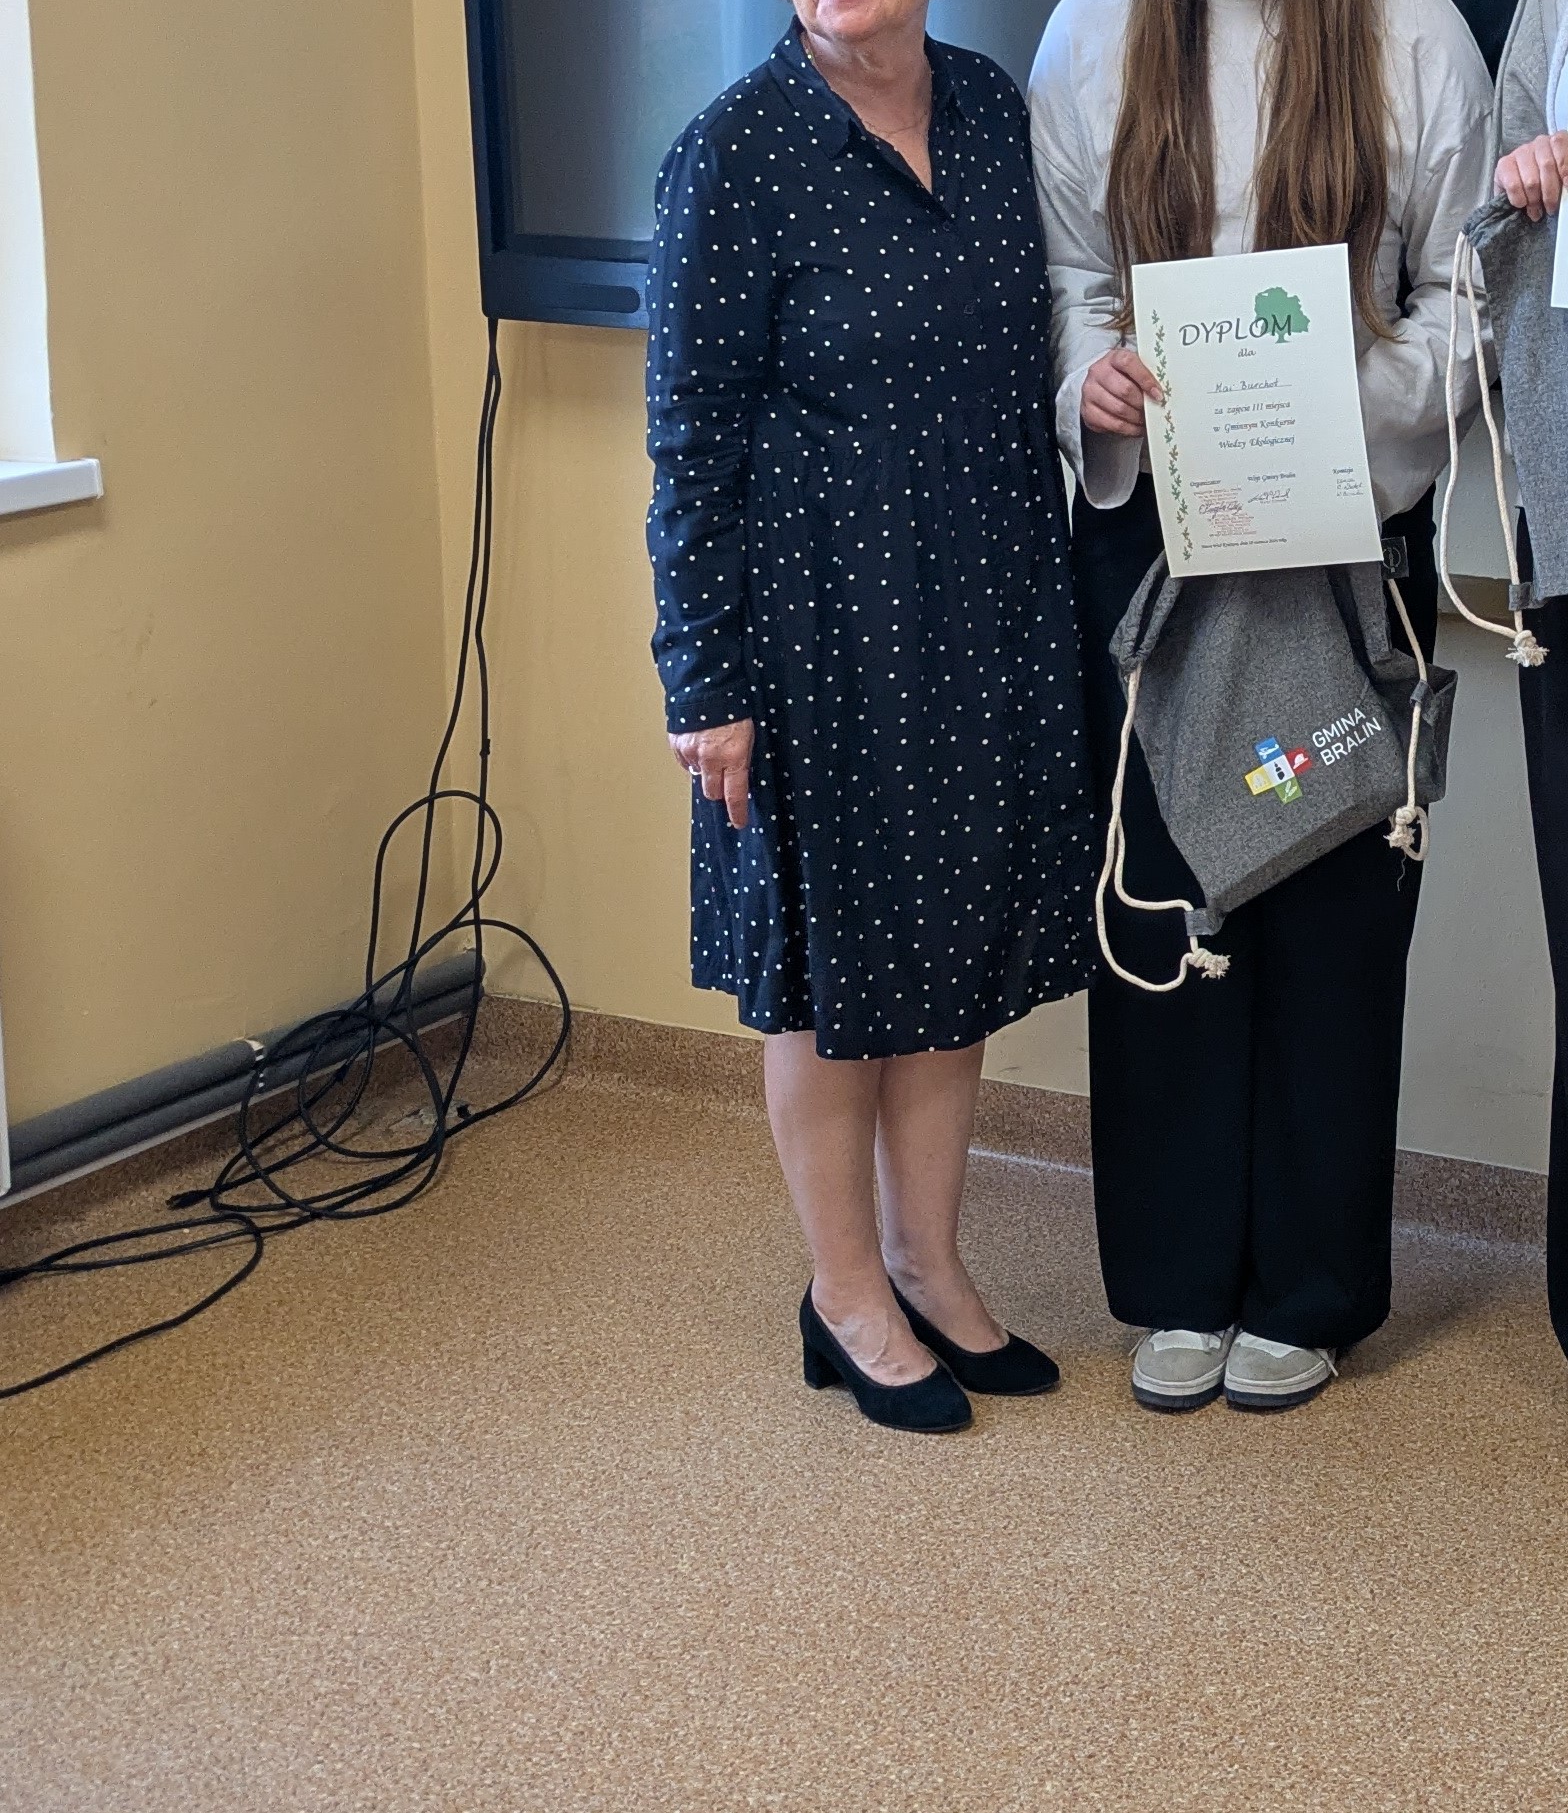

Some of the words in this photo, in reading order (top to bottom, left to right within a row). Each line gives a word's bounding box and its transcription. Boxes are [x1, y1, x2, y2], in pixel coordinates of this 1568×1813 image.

[1178, 314, 1292, 346] DYPLOM
[1237, 348, 1257, 358] dla
[1252, 402, 1264, 412] III
[1218, 438, 1247, 449] Wiedzy
[1312, 707, 1366, 748] GMINA
[1319, 716, 1382, 766] BRALIN
